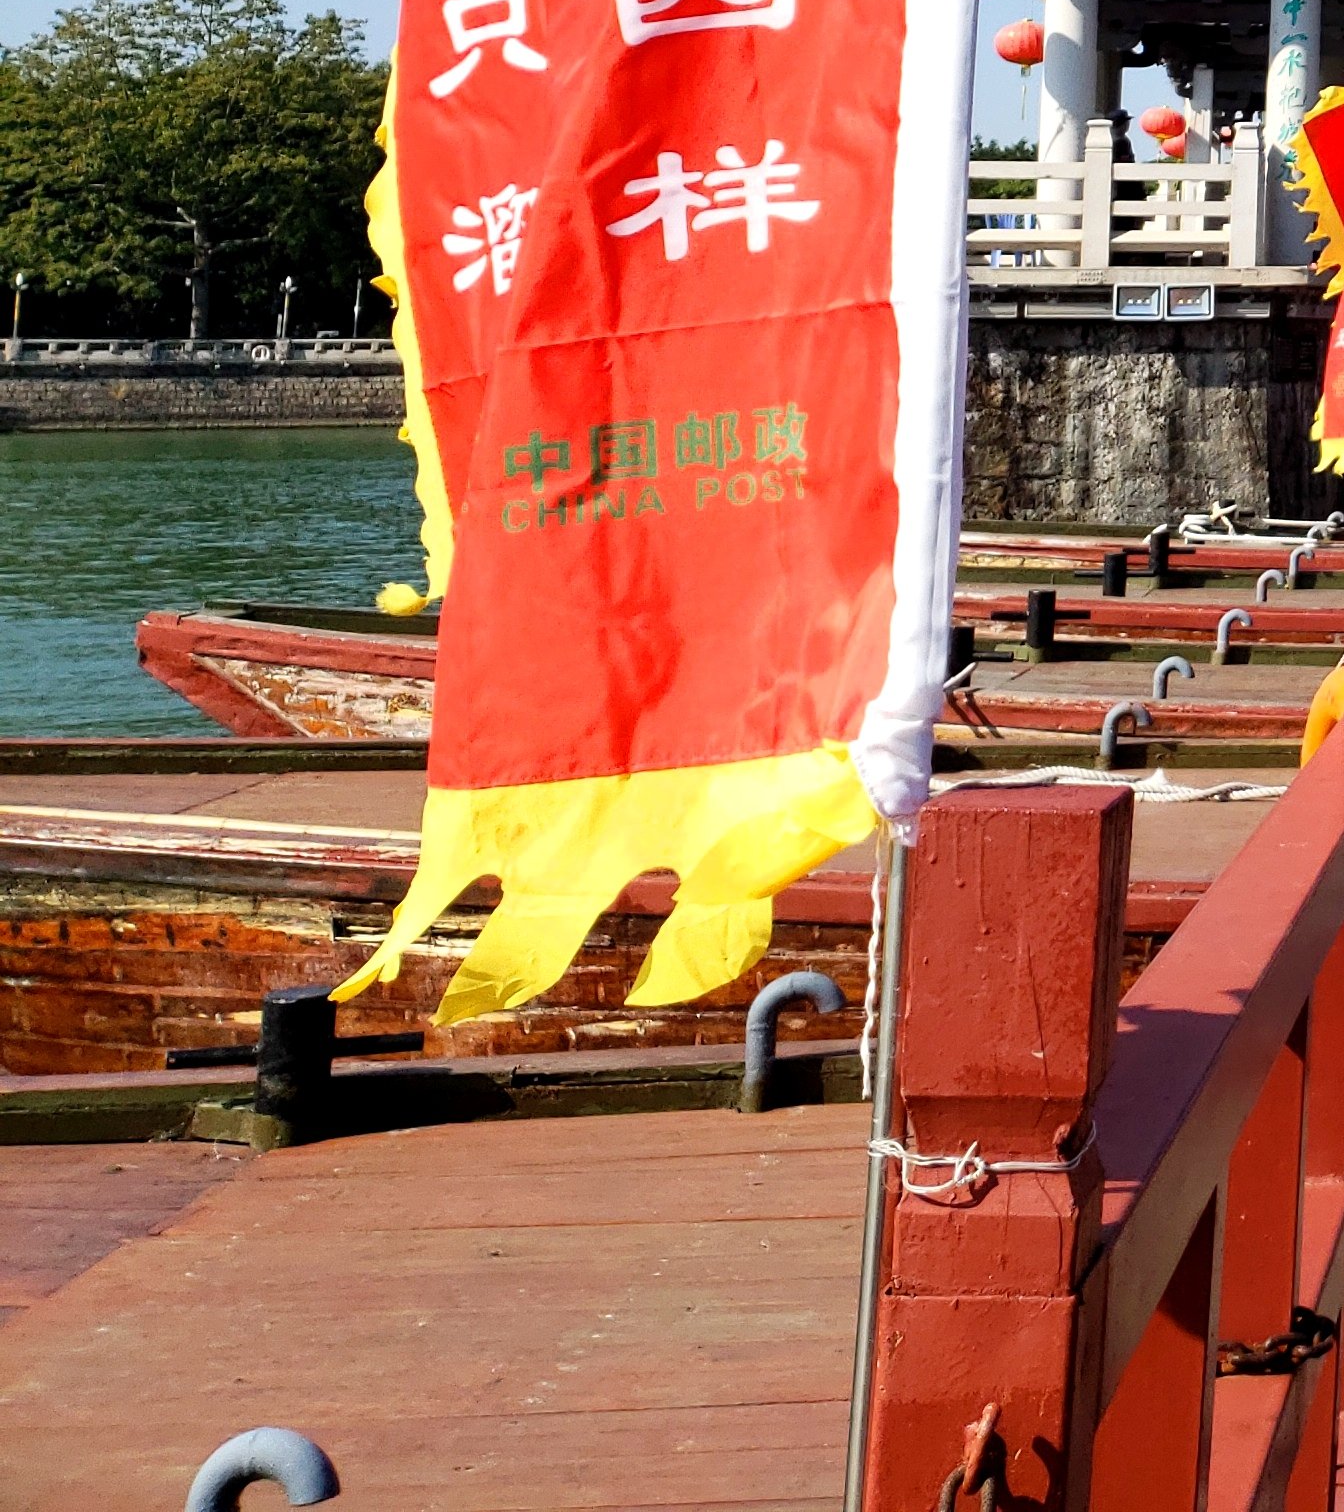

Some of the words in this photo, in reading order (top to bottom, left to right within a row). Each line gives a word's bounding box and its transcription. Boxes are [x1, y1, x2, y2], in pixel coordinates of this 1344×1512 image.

[503, 402, 808, 492] 中国邮政
[501, 484, 664, 532] CHINA
[696, 466, 807, 510] POST
